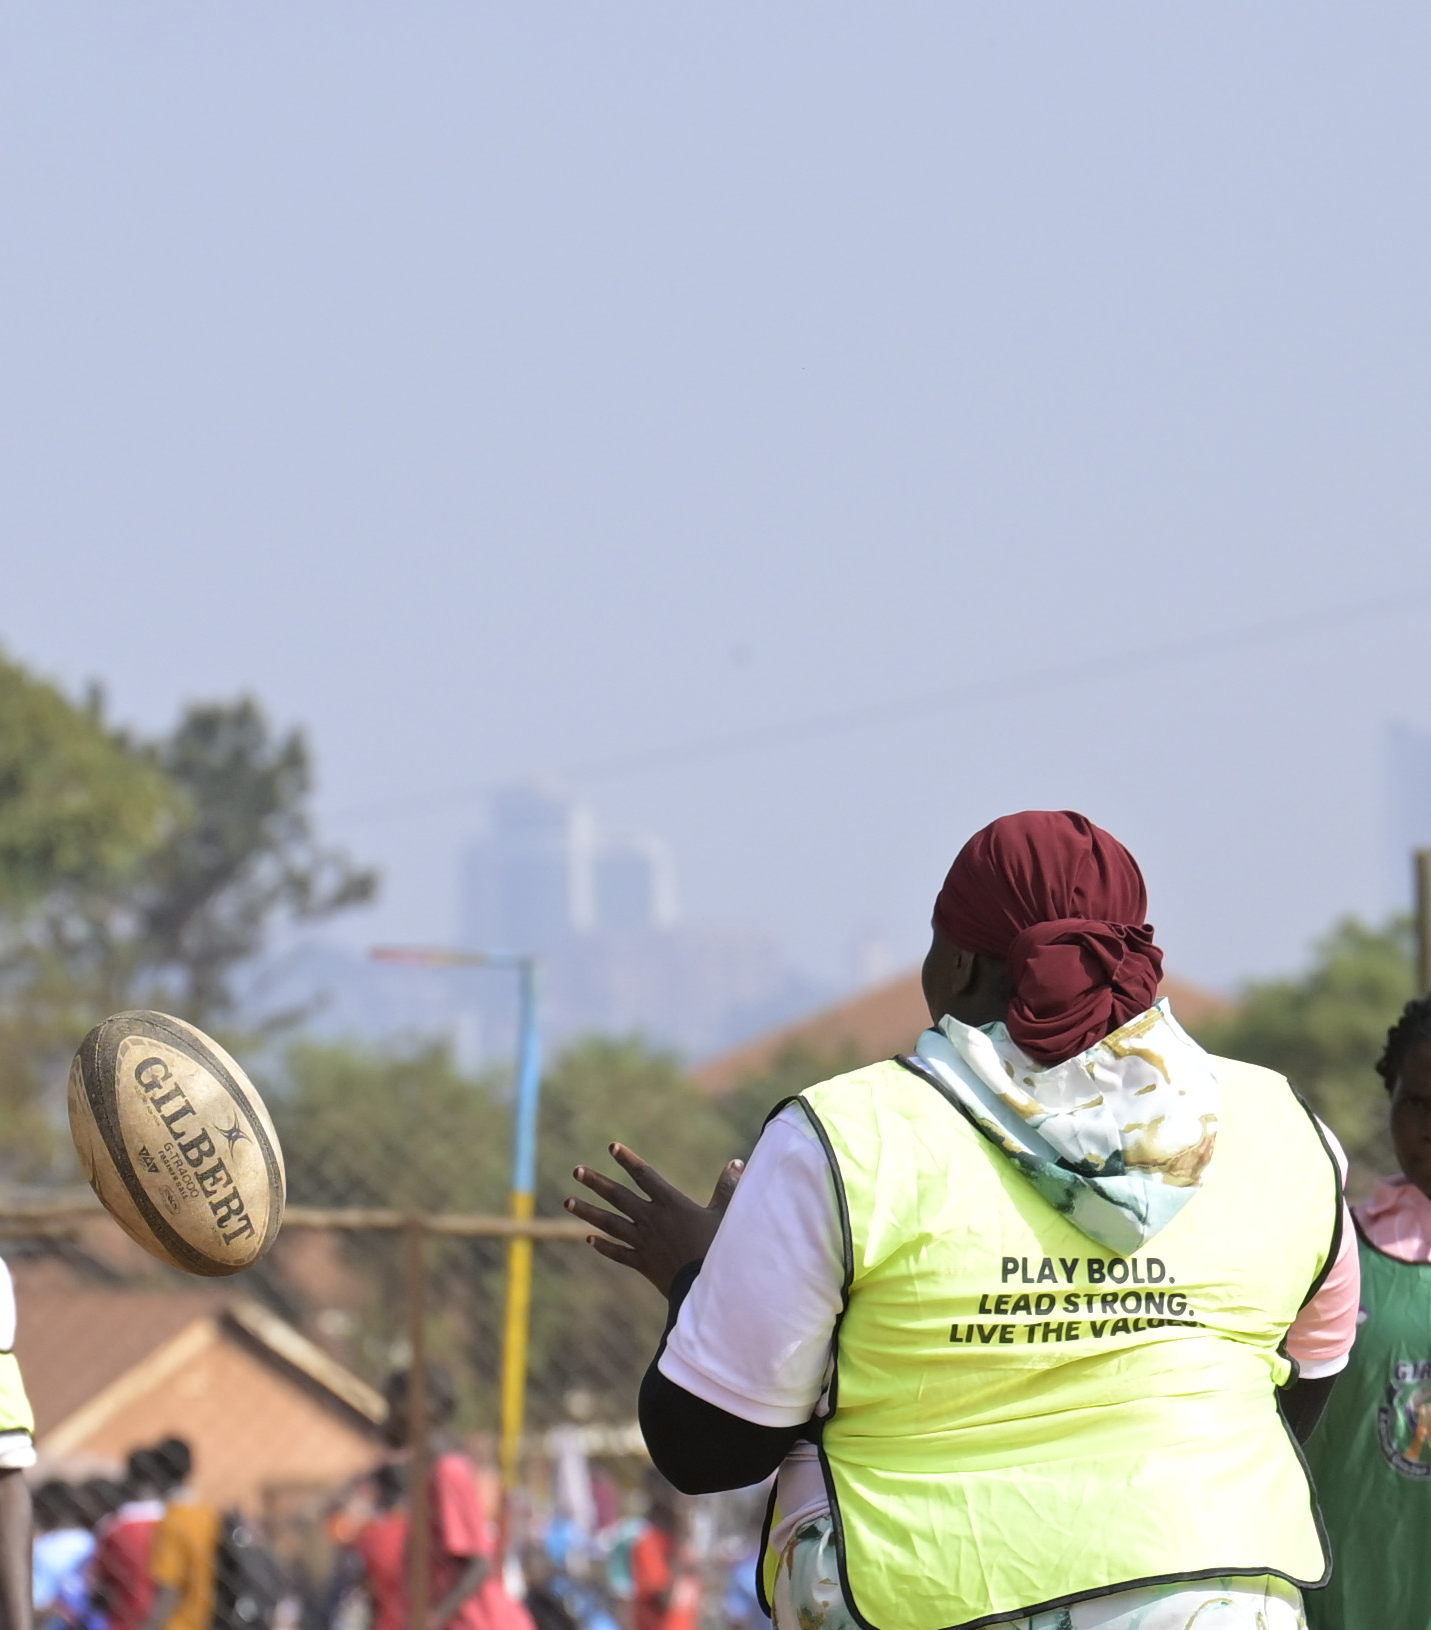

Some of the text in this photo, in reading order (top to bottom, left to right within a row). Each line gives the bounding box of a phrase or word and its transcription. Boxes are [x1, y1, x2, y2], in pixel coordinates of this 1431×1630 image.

[134, 1056, 255, 1246] GILBERT
[164, 1142, 200, 1199] G-TR4000
[1001, 1256, 1176, 1285] PLAY BOLD.
[978, 1290, 1195, 1317] LEAD STRONG.
[949, 1323, 1015, 1344] LIVE
[1023, 1320, 1080, 1344] THE
